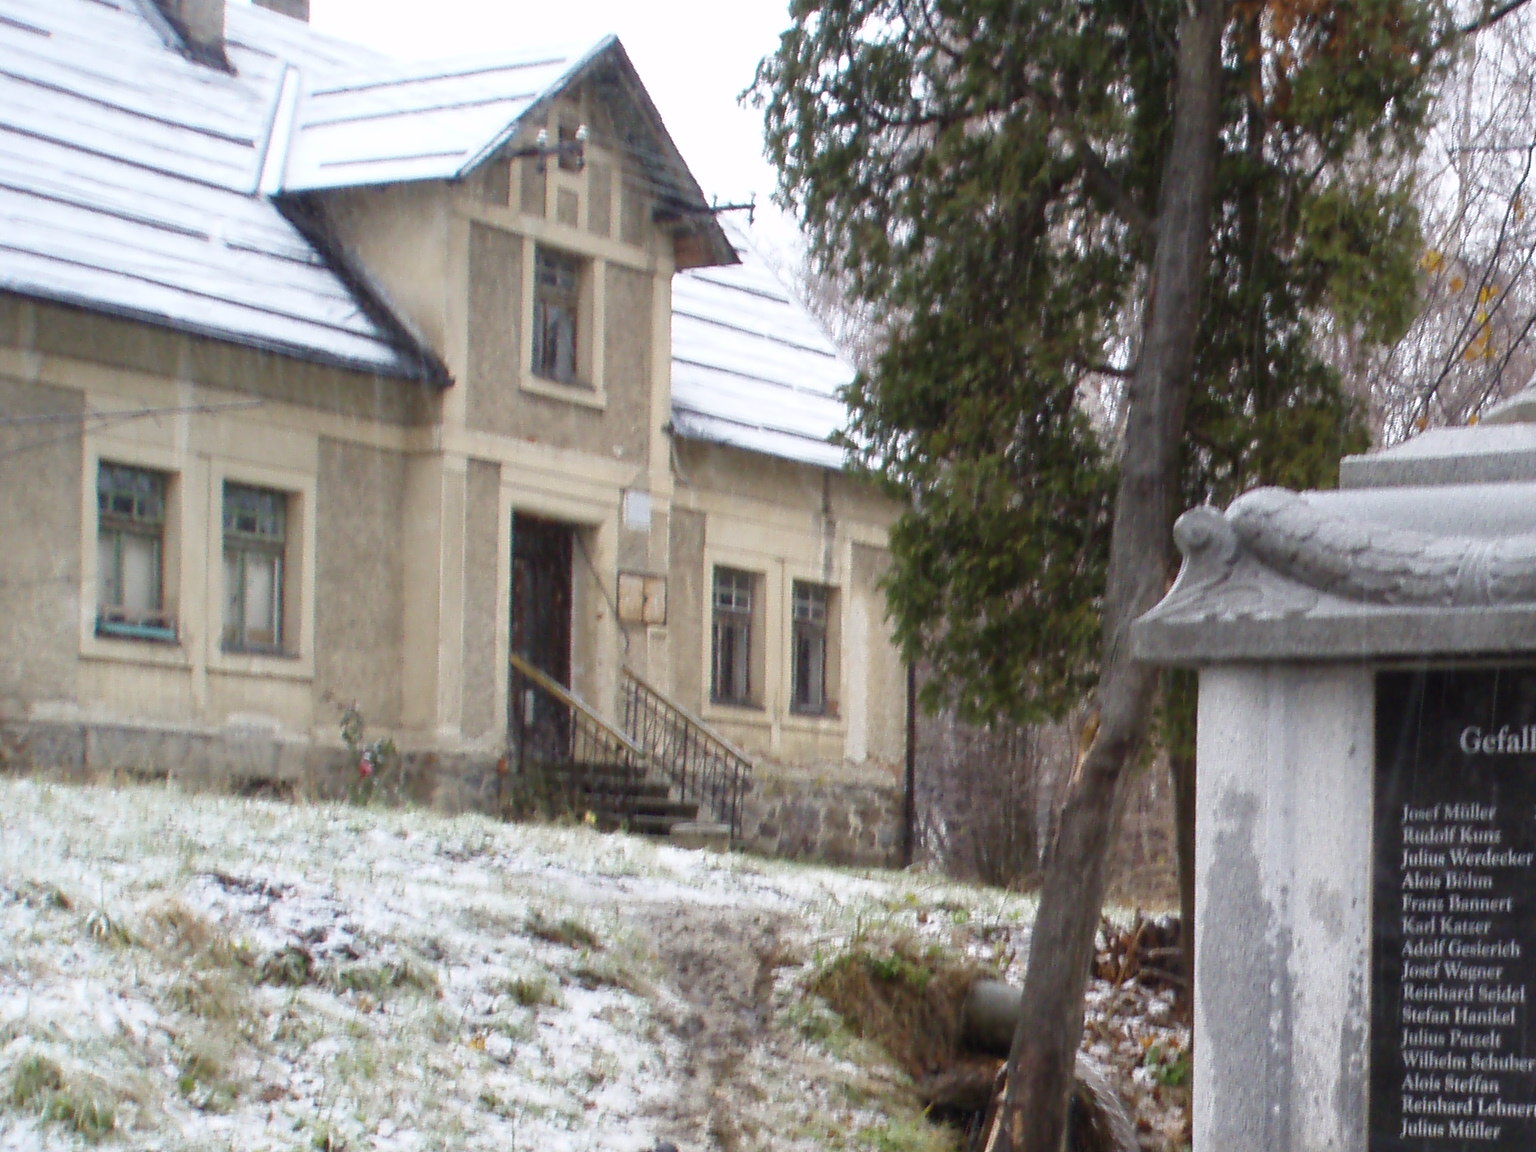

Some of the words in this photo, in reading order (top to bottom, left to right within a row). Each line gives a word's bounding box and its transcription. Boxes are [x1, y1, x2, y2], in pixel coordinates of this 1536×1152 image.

[1401, 803, 1439, 825] Josef
[1444, 803, 1496, 820] Müller
[1402, 825, 1457, 844] Rudolf
[1401, 849, 1446, 870] Julius
[1449, 849, 1534, 866] Werdecker
[1402, 872, 1440, 890] Alois
[1446, 871, 1493, 889] Böhm
[1402, 895, 1444, 912] Franz
[1449, 894, 1513, 912] Bannert
[1402, 917, 1436, 935] Karl
[1402, 939, 1446, 957] Adolf
[1401, 960, 1439, 982] Josef
[1444, 961, 1503, 982] Wagner
[1403, 983, 1473, 1002] Reinhard
[1478, 985, 1525, 1003] Seidel
[1402, 1006, 1449, 1025] Stefan
[1401, 1029, 1445, 1049] Julius
[1402, 1050, 1467, 1070] Wilhelm
[1402, 1073, 1440, 1091] Alois
[1444, 1074, 1500, 1093] Steffan
[1402, 1095, 1472, 1115] Reinhard
[1400, 1117, 1444, 1139] Julius
[1448, 1119, 1501, 1140] Müller
